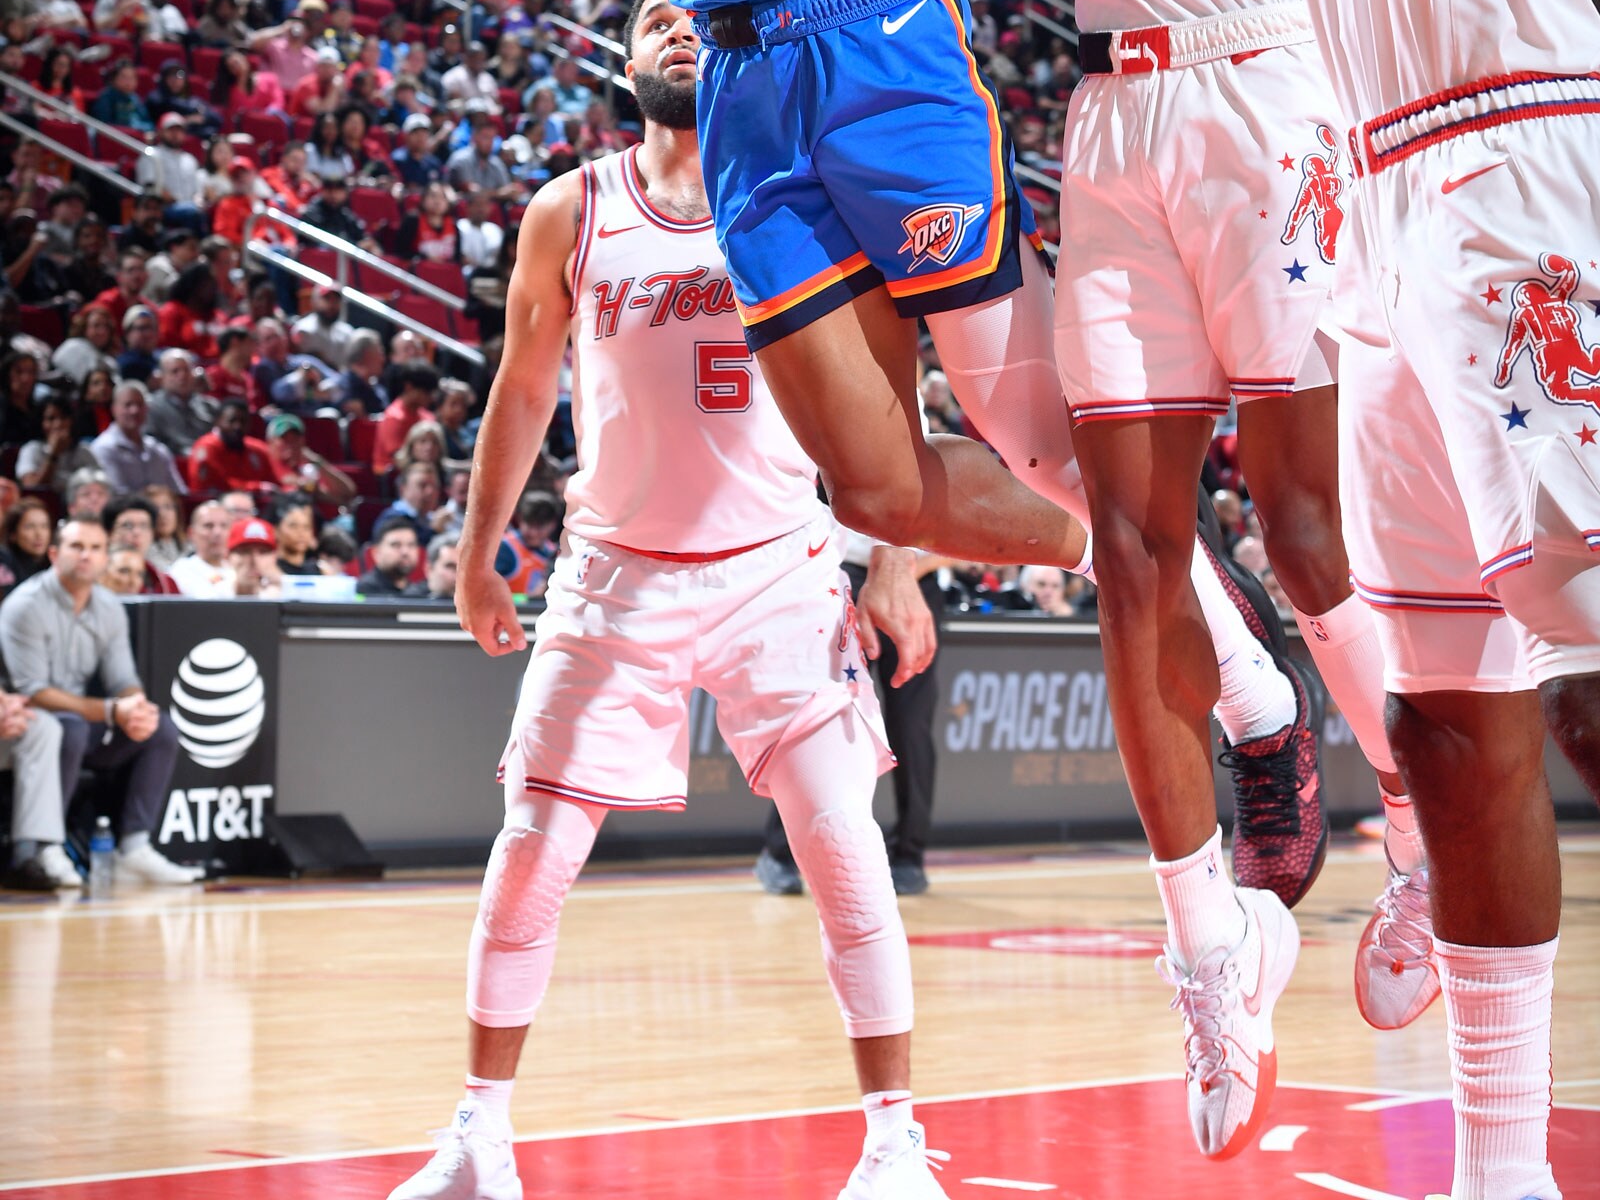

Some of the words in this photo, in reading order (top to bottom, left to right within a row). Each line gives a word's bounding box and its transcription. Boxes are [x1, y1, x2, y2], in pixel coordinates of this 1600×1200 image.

[913, 212, 952, 257] OKC
[593, 265, 738, 340] H-Tow
[694, 341, 753, 413] 5
[946, 670, 1067, 752] SPACE
[159, 784, 274, 844] AT&T
